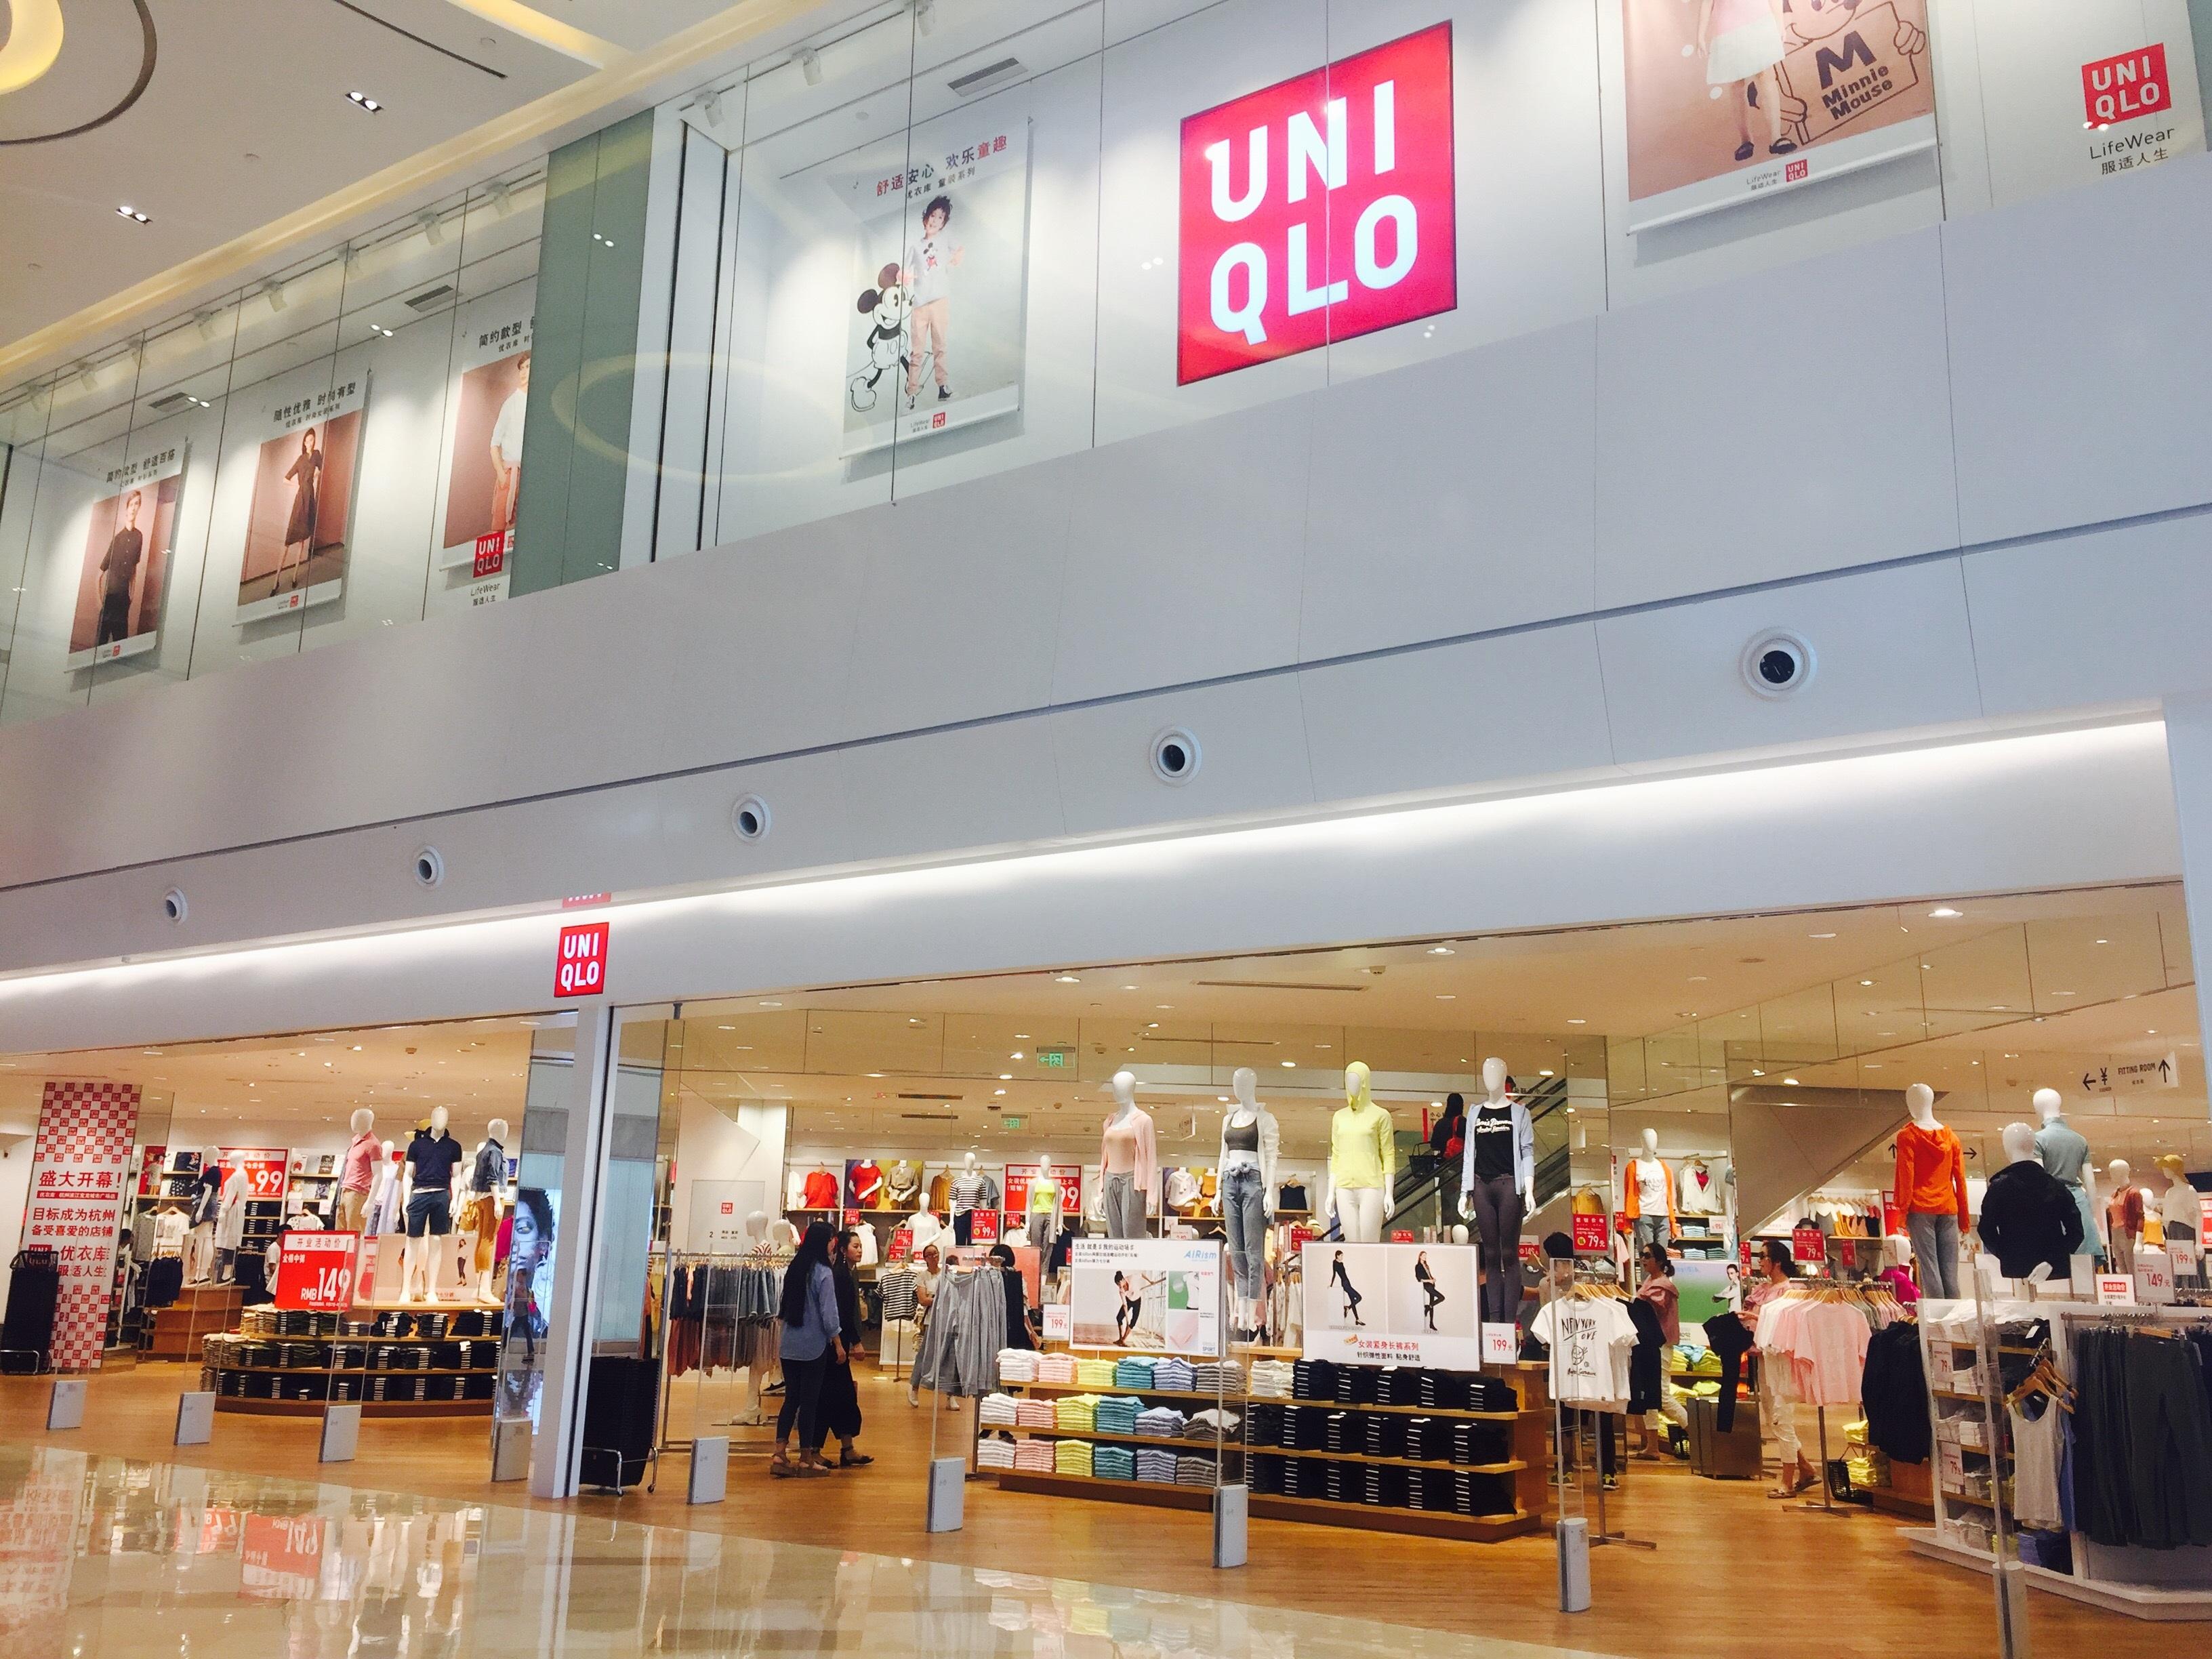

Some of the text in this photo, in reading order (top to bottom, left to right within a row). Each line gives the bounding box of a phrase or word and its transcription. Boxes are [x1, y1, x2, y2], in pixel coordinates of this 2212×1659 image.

[1816, 30, 1877, 90] M
[2091, 56, 2151, 91] UNI
[1822, 66, 1888, 108] Minnie
[1830, 79, 1893, 120] Mouse
[2095, 82, 2160, 120] QLO
[1210, 79, 1395, 222] UNI
[2089, 128, 2175, 159] LifeWear
[876, 135, 1006, 197] 舒适安心 欢乐童趣
[1788, 162, 1804, 171] UNI
[2102, 147, 2169, 175] 服适人生
[938, 166, 975, 188] 童装系列
[1746, 170, 1780, 185] LifeWear
[1788, 169, 1806, 180] QLO
[1210, 194, 1418, 345] QLO
[478, 537, 499, 555] UNI
[477, 554, 499, 573] QLO
[470, 583, 500, 596] LifeWear
[563, 933, 599, 959] UNI
[560, 961, 599, 991] QLO
[2118, 1062, 2156, 1075] FITTING ROOM
[39, 1170, 121, 1188] 盛大开幕!
[33, 1207, 116, 1222] 目标成为杭州
[32, 1225, 114, 1237] 备受喜爱的店铺
[297, 1237, 341, 1248] 开业活动价
[60, 1245, 107, 1261] 优衣库
[1184, 1250, 1216, 1258] AIRism
[58, 1265, 104, 1277] 服适人生
[300, 1267, 351, 1301] RMB 149
